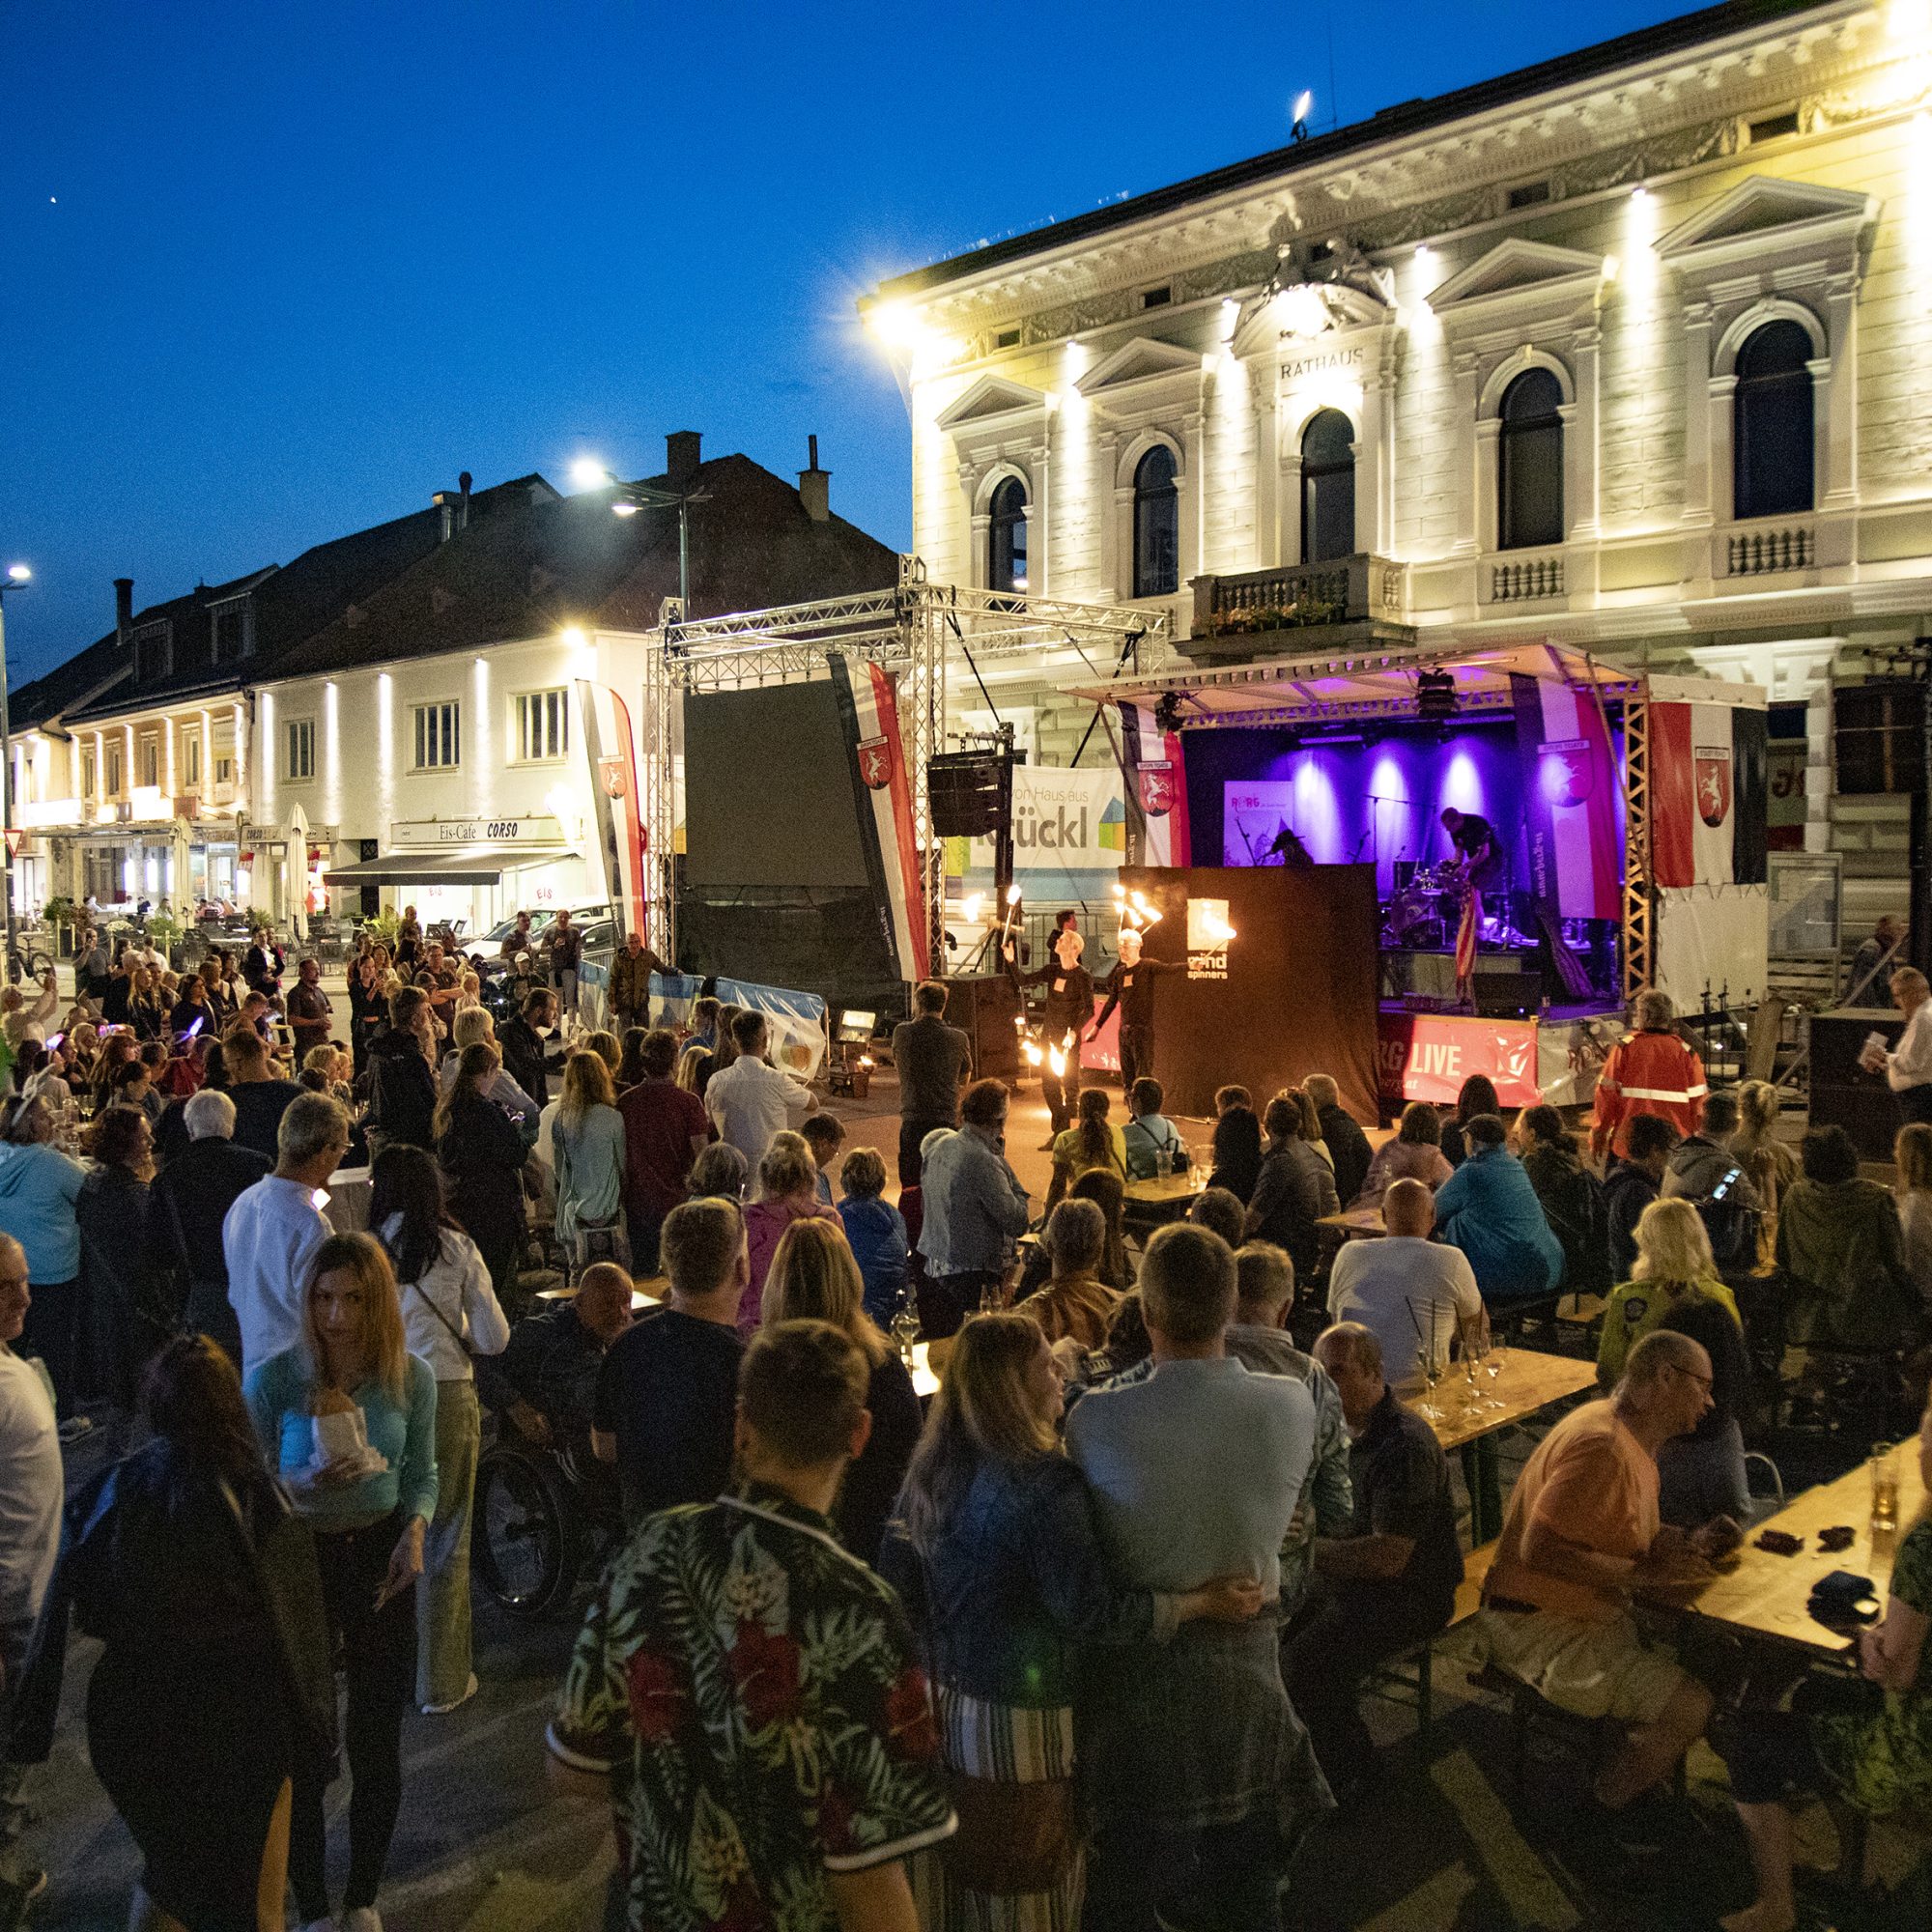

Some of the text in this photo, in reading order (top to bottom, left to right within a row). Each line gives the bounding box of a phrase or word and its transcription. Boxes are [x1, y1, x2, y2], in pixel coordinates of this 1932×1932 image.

[1281, 348, 1363, 379] RATHAUS
[1035, 786, 1064, 801] Haus
[1068, 790, 1088, 802] aus
[440, 822, 518, 839] Eis-Cafe CORSO
[978, 806, 1088, 849] ückl
[536, 888, 553, 899] EIS
[1187, 971, 1228, 980] spinners
[1410, 1042, 1462, 1075] LIVE
